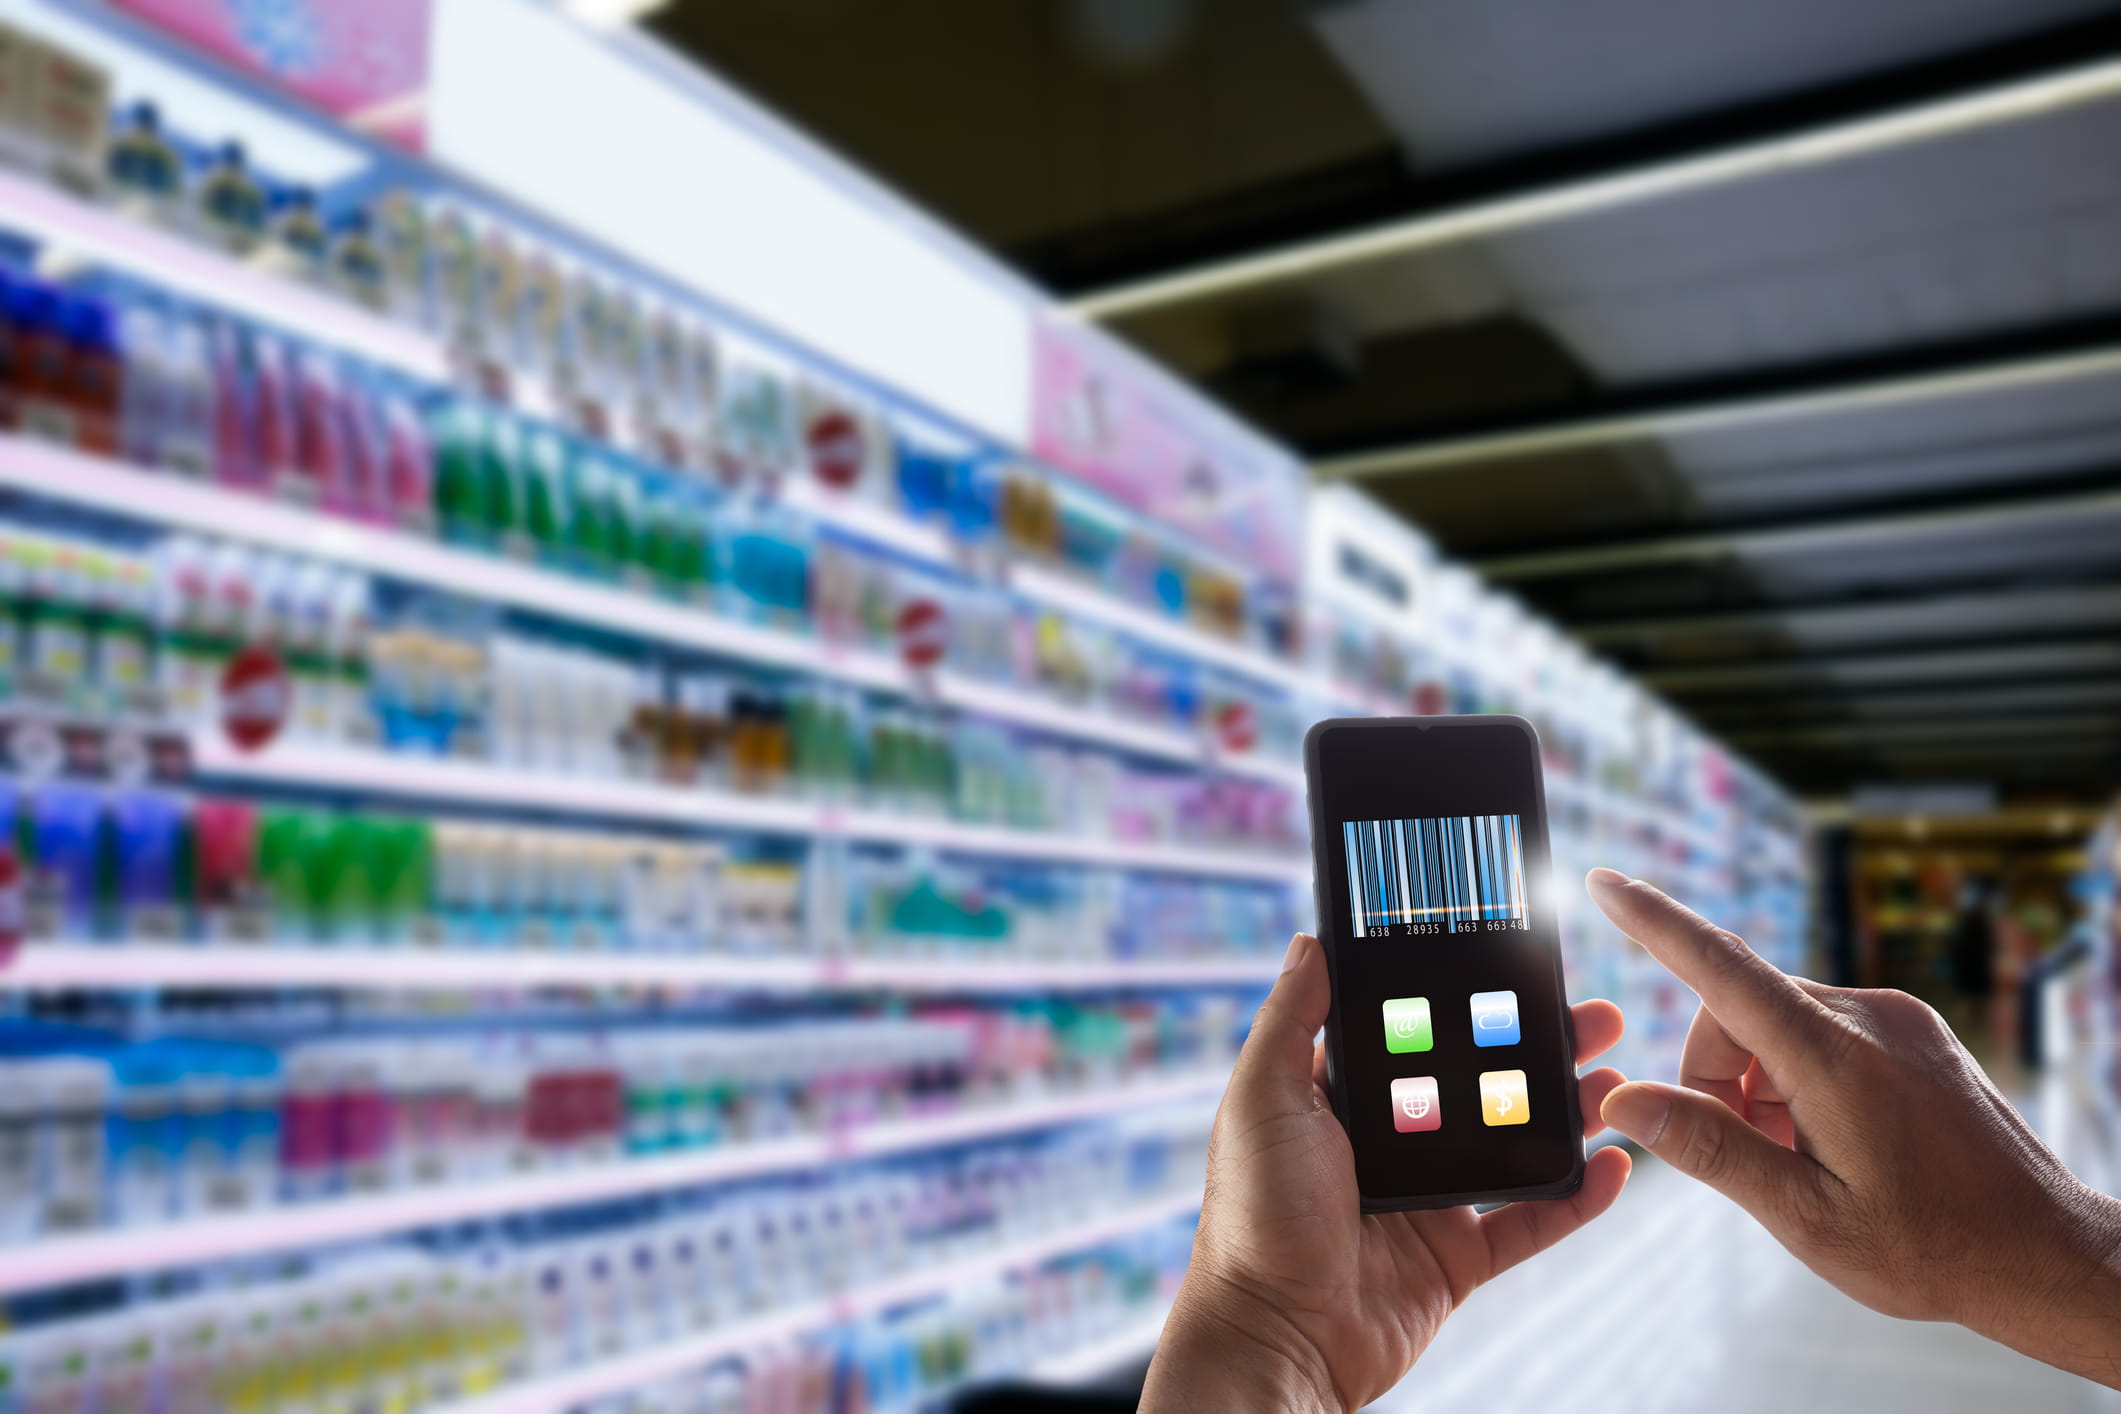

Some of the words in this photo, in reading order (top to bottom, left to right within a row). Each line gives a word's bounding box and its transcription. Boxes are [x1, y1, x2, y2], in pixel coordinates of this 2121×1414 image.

[1370, 927, 1390, 937] 638
[1406, 924, 1440, 935] 28935
[1458, 922, 1478, 933] 663
[1487, 920, 1507, 931] 663
